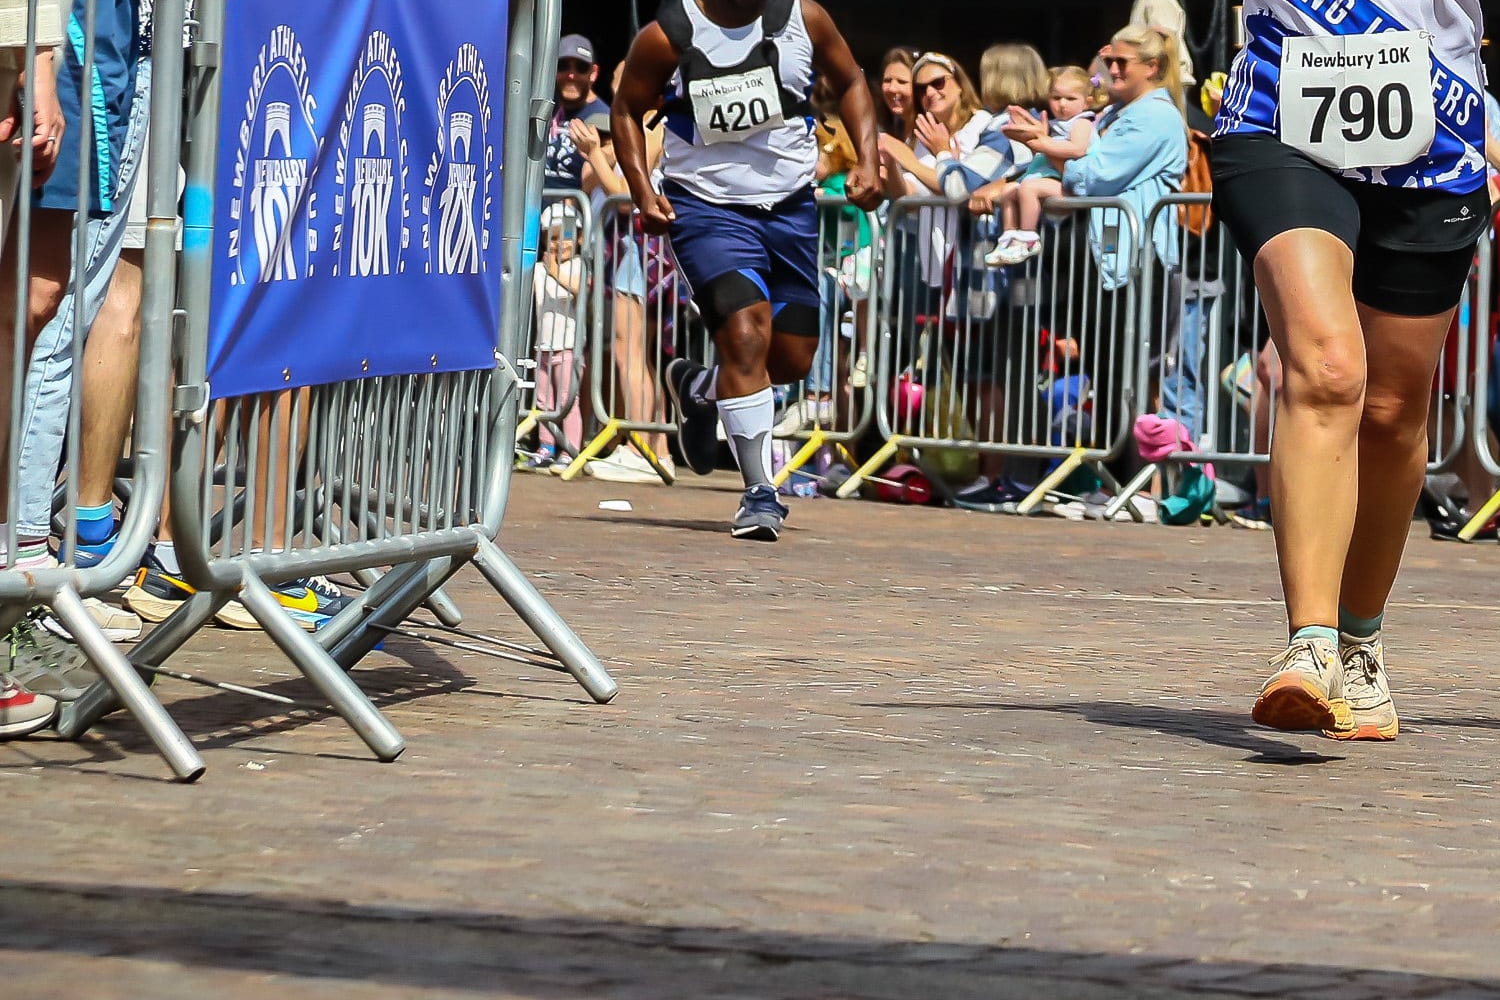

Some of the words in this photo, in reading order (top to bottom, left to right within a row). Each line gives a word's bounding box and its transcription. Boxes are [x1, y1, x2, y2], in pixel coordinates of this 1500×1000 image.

[268, 24, 317, 125] ATHLETIC
[744, 76, 765, 89] 10K
[1301, 51, 1375, 69] Newbury
[1378, 47, 1410, 64] 10K
[333, 49, 366, 250] NEWBURY
[366, 30, 406, 125] ATHLETIC
[400, 138, 410, 250] CLUB
[456, 42, 491, 133] ATHLETIC
[482, 145, 493, 250] CLUB
[709, 97, 770, 132] 420
[1301, 83, 1413, 143] 790
[350, 177, 393, 277] 10K
[438, 180, 478, 275] 10K
